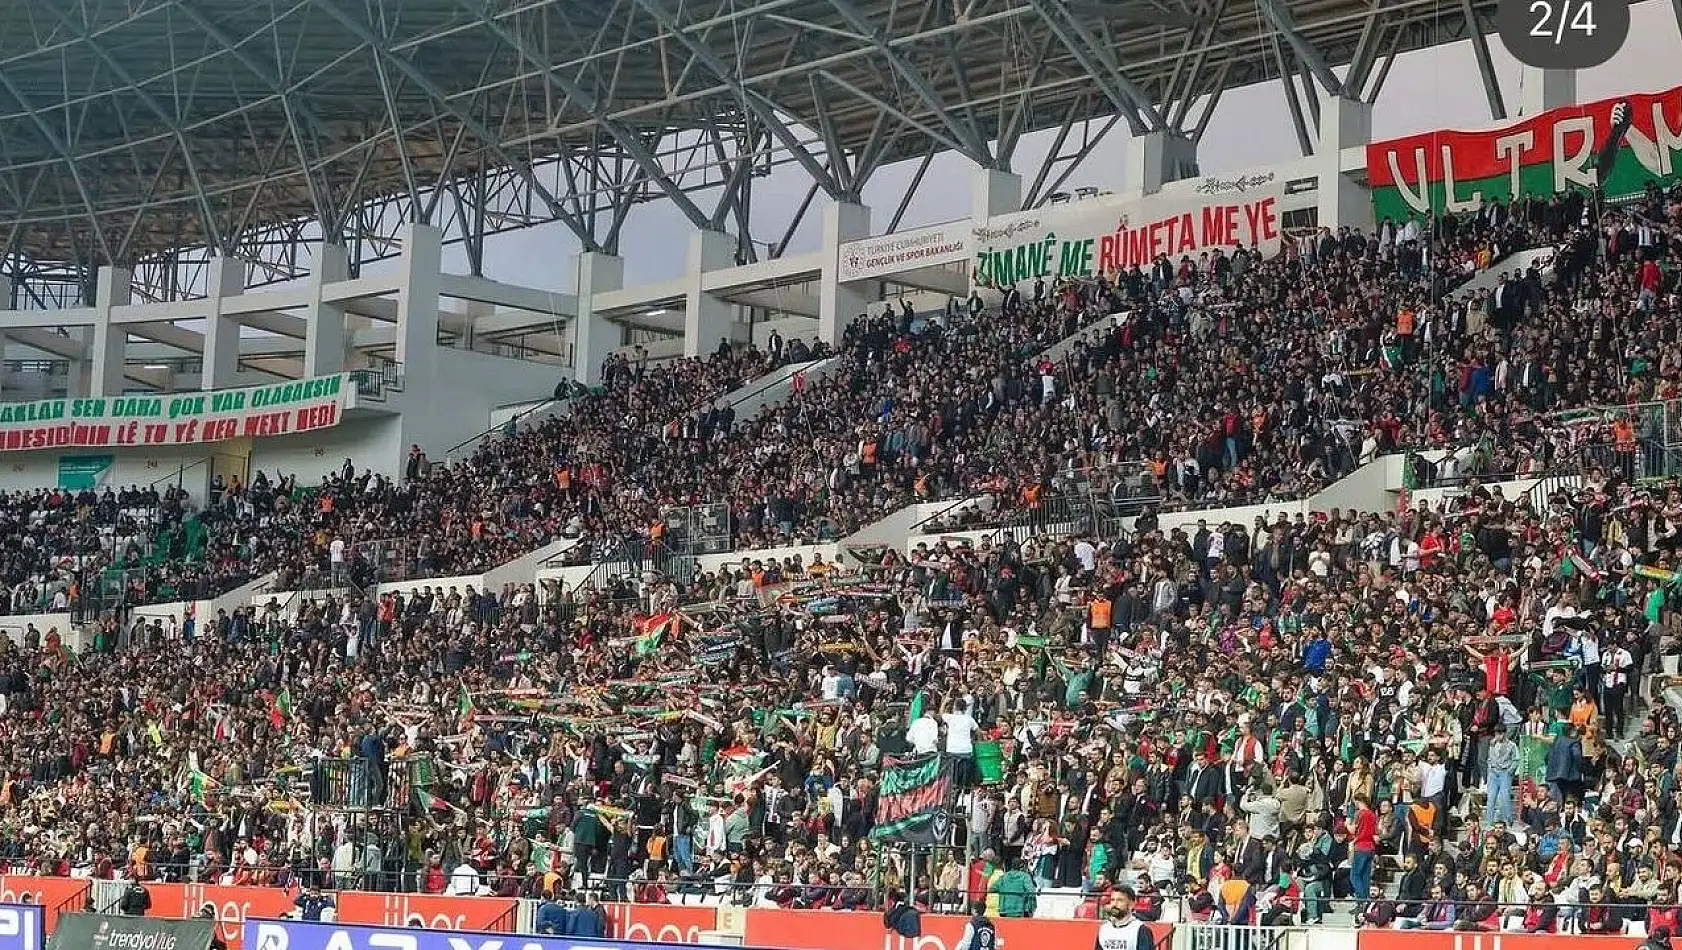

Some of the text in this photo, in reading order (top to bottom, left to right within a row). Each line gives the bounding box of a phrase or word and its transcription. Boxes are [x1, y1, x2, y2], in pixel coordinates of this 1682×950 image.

[1059, 238, 1094, 276] ME
[1099, 213, 1196, 269] RÛMETA
[1202, 205, 1239, 247] ME
[1244, 197, 1278, 245] YE
[906, 248, 924, 261] SPOR
[71, 399, 106, 418] SEN
[112, 398, 161, 418] DAHA
[212, 391, 246, 412] VAR
